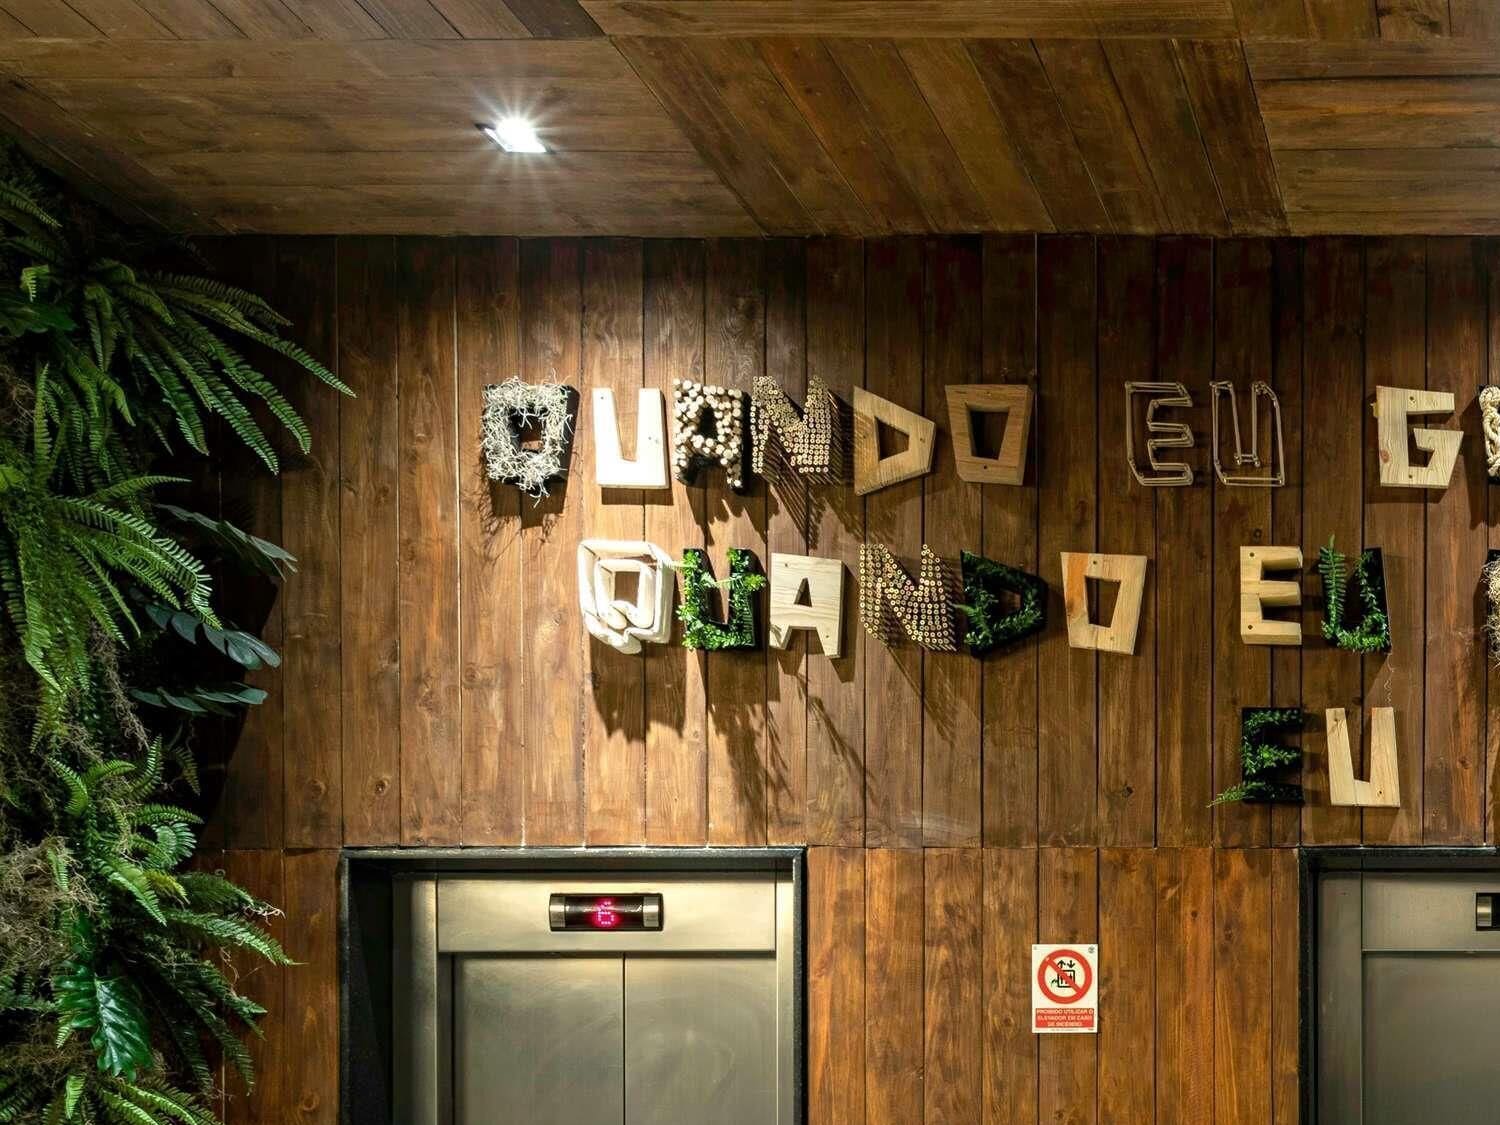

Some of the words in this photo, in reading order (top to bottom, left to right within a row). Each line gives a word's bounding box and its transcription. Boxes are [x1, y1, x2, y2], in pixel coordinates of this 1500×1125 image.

[481, 376, 1034, 498] QUANDO
[1125, 380, 1285, 488] EU
[577, 538, 1148, 659] QUANDO
[1239, 537, 1390, 652] EU
[1236, 706, 1400, 808] EU
[597, 901, 615, 925] 6
